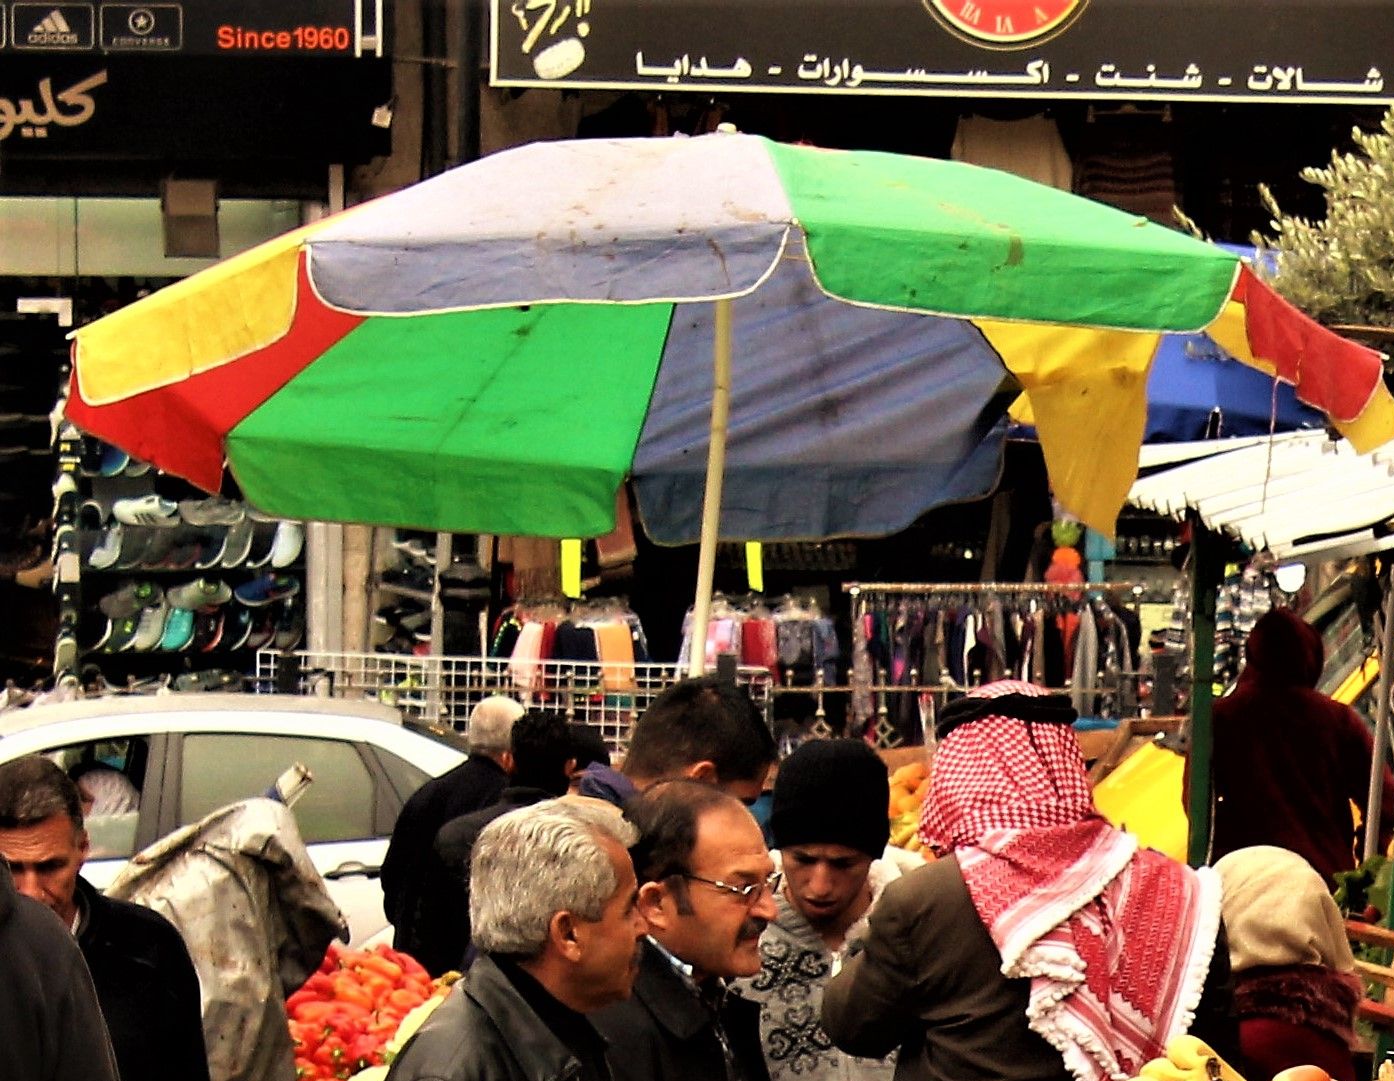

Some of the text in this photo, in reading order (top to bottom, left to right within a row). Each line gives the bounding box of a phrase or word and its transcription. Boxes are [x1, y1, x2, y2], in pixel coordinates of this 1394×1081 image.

[635, 50, 752, 83] هدايا
[797, 53, 1050, 87] اكسسوارات
[1094, 63, 1202, 89] شنت
[1247, 66, 1384, 93] شالات
